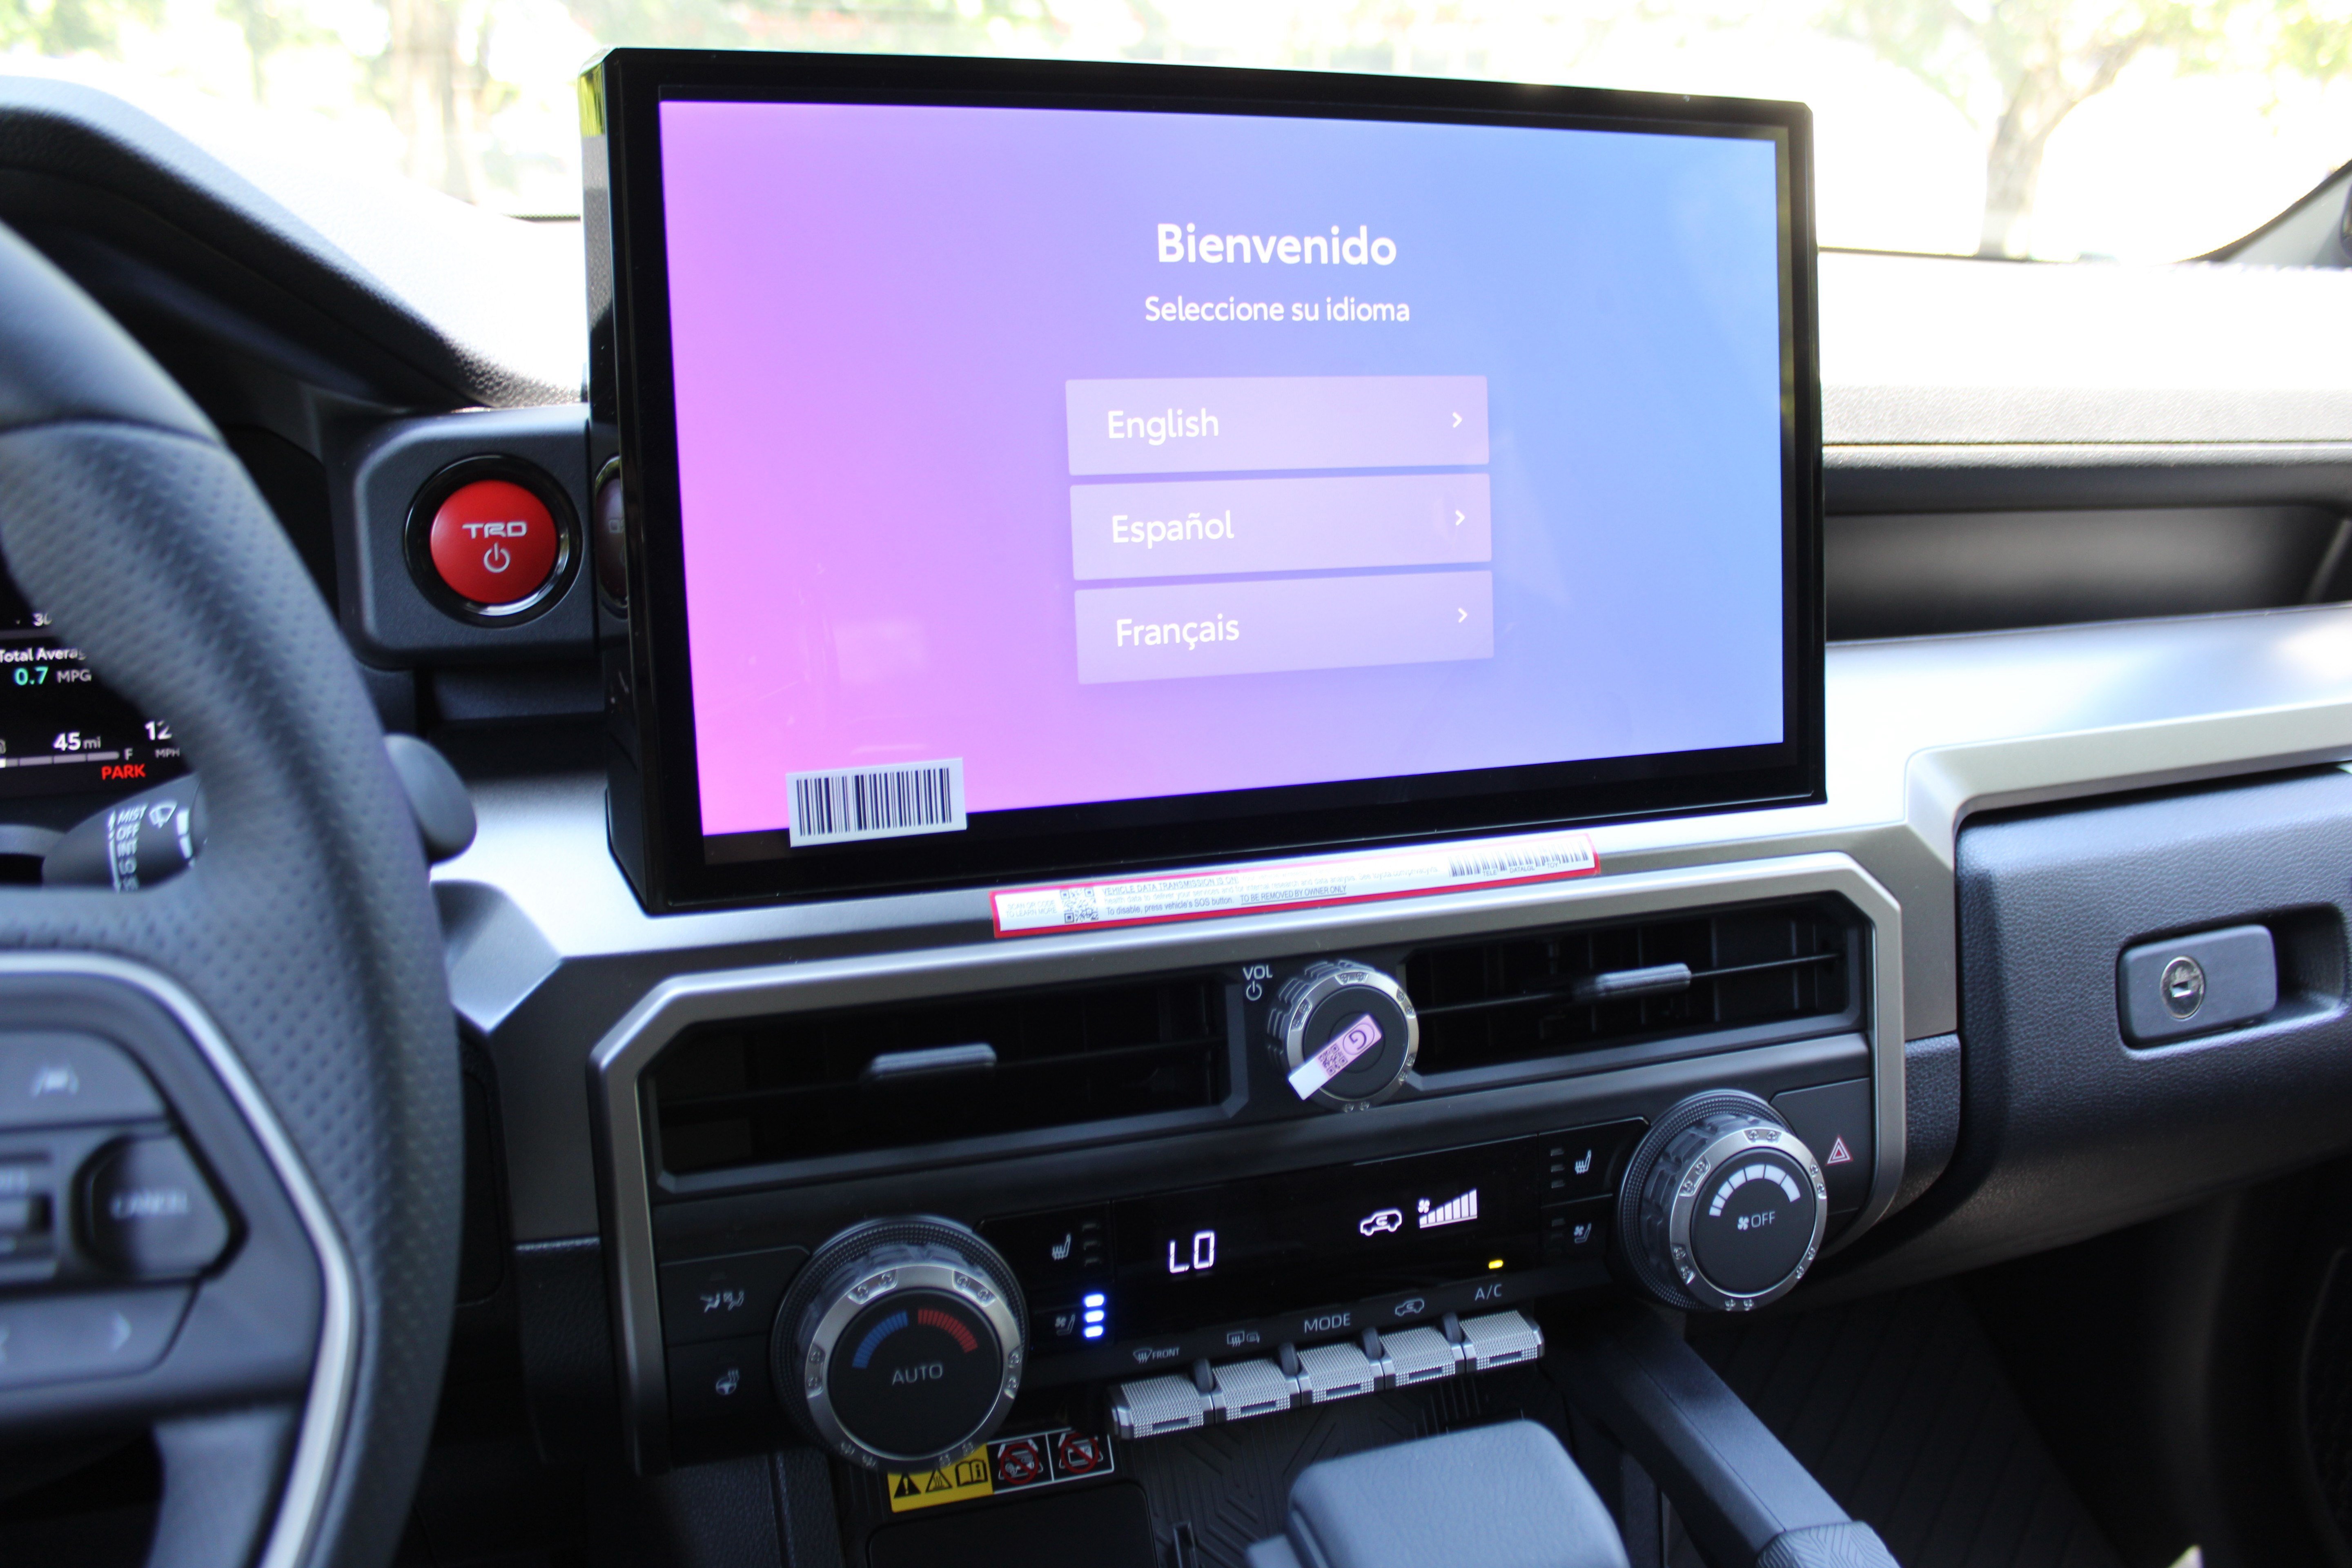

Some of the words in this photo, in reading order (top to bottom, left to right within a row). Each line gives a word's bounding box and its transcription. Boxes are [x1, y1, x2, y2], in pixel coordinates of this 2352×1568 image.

[1157, 223, 1396, 265] Bienvenido
[1145, 295, 1284, 322] Seleccione
[1292, 302, 1319, 322] su
[1326, 296, 1410, 322] idioma
[1107, 408, 1219, 445] English
[462, 521, 527, 539] TRD
[1111, 510, 1235, 549] Español
[1116, 614, 1240, 650] Français
[0, 646, 34, 663] Total
[14, 666, 48, 686] 0.7
[56, 668, 92, 684] MPG
[53, 732, 81, 751] 45
[83, 736, 101, 749] mi
[124, 747, 133, 761] F
[154, 748, 180, 758] MPH
[101, 763, 146, 780] PARK
[117, 802, 148, 825] MIST
[1103, 885, 1135, 895] VEHICLE
[1137, 884, 1157, 893] DATA
[1158, 878, 1215, 891] TRANSMISSION
[1177, 891, 1190, 900] your
[1272, 880, 1299, 888] research
[1240, 894, 1250, 903] TO
[1251, 893, 1259, 902] BE
[1261, 890, 1294, 900] REMOVED
[1295, 889, 1303, 898] BY
[1304, 886, 1329, 896] OWNER
[1330, 884, 1347, 894] ONLY
[1016, 908, 1037, 917] LEARN
[1038, 906, 1057, 915] MORE
[1106, 907, 1114, 915] To
[1116, 905, 1143, 914] disable,
[1144, 904, 1163, 914] press
[1165, 900, 1193, 910] vehicle's
[1194, 898, 1210, 907] SOS
[1243, 964, 1273, 980] VOL
[1751, 1210, 1775, 1229] OFF
[1169, 1230, 1215, 1273] LO
[1475, 1283, 1501, 1301] A/C
[1304, 1313, 1351, 1334] MODE
[1152, 1347, 1180, 1361] FRONT
[892, 1363, 943, 1386] AUTO
